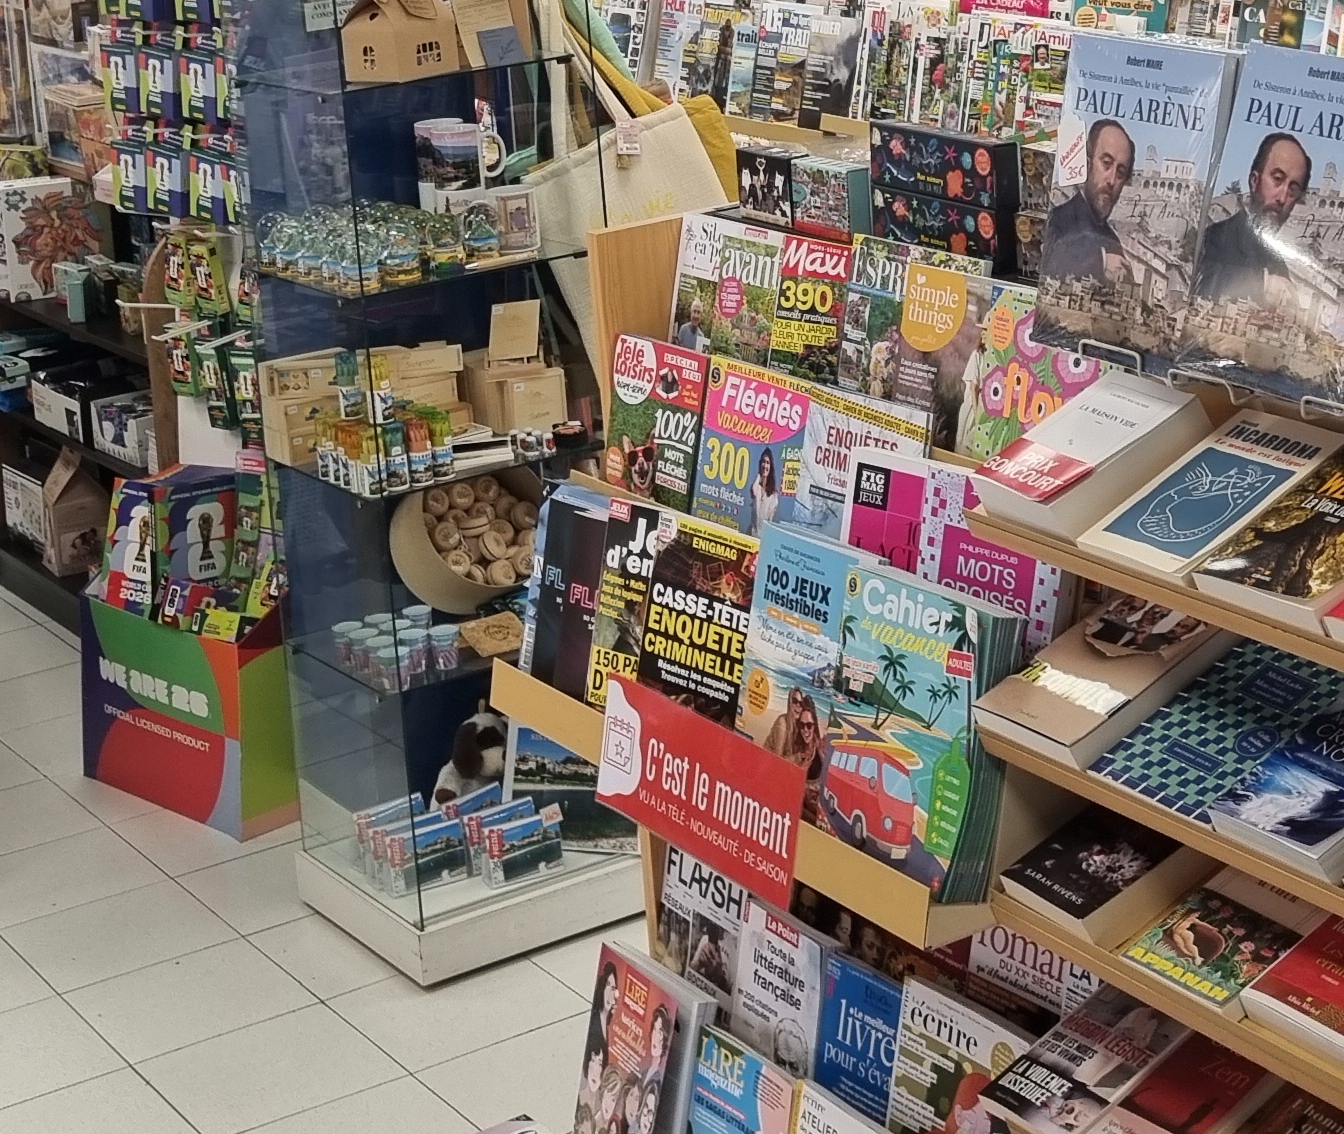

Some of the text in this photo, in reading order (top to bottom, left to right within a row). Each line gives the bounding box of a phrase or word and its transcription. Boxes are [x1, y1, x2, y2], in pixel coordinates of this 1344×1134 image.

[1075, 86, 1206, 133] PAUL ARÈNE
[1244, 97, 1305, 135] PAUL
[783, 248, 848, 278] Maxi
[780, 281, 833, 311] 390
[910, 283, 959, 311] simple
[908, 303, 954, 331] things
[619, 338, 644, 363] Télé
[615, 360, 655, 385] Loisirs
[727, 363, 787, 388] MEILLEURE VENTE
[721, 376, 802, 431] Fléchés
[654, 408, 696, 446] 100%
[717, 410, 774, 444] vacances
[1223, 423, 1322, 462] INCARDONA
[665, 448, 684, 462] MOTS
[704, 437, 750, 490] 300
[1018, 449, 1059, 472] PRIX
[860, 481, 884, 494] MAG
[861, 470, 885, 484] FIG
[983, 454, 1064, 493] GONCOURT
[700, 483, 745, 507] mots fléchés
[858, 492, 882, 506] JEUX
[692, 536, 737, 561] ENIGMAG
[960, 542, 1018, 564] PHILIPPE DUPUIS
[766, 564, 832, 606] 100 JEUX
[957, 556, 1016, 588] MOTS
[120, 589, 151, 604] 2026
[652, 583, 748, 632] CASSE-TÊTE
[763, 585, 829, 624] irrésistibles
[863, 579, 953, 634] Cahier
[99, 656, 127, 688] WE
[104, 704, 210, 752] OFFICIAL LICENSED PRODUCT
[646, 737, 791, 859] C'est le moment
[691, 817, 788, 885] NOUVEAUTÉ SAISON
[1024, 868, 1084, 906] SARAH RIVENS
[663, 893, 692, 918] RÉSEAUX
[777, 919, 799, 945] Point
[766, 939, 786, 960] Toute
[753, 949, 806, 993] littérature
[1127, 947, 1231, 1001] APPANAH
[753, 969, 802, 1011] française
[836, 998, 897, 1065] livre
[910, 1006, 979, 1058] écrire
[823, 1040, 857, 1073] pour
[1024, 1062, 1073, 1096] VIOLENCE
